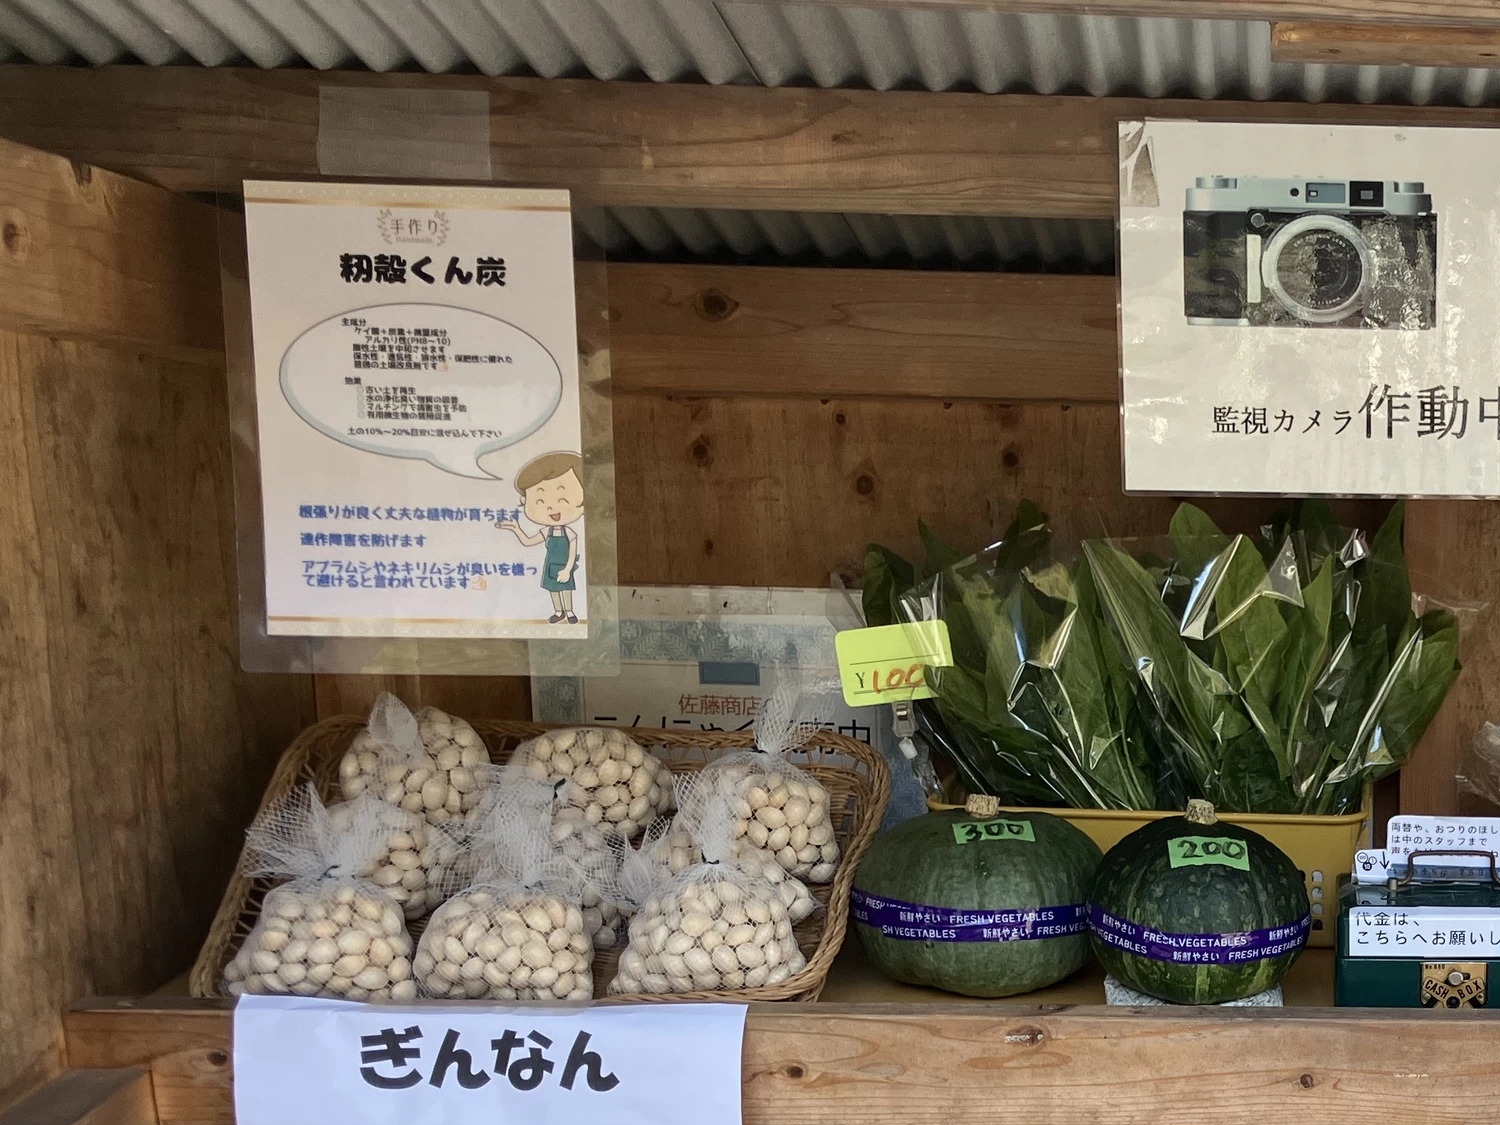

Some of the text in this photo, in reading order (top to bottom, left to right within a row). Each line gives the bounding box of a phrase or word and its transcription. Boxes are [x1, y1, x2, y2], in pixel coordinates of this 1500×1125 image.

[390, 218, 438, 236] 手作り
[339, 254, 507, 287] 籾殻くん炭
[299, 505, 523, 521] 根張りが良く丈夫な植物が育ちます
[300, 532, 427, 547] 連作障害を防げます
[960, 820, 1025, 843] 300
[1391, 836, 1488, 846] は中のスタッフまで
[1176, 838, 1247, 862] 200
[899, 911, 942, 924] 新鮮やさい
[949, 911, 1054, 924] FRESH VEGETABLES
[1102, 913, 1136, 936] 新鮮やさい
[1355, 911, 1421, 928] 代金は、
[894, 926, 956, 939] VEGETABLES
[983, 927, 1031, 940] 新鮮やさい
[1037, 924, 1067, 936] FRESH
[1268, 924, 1299, 942] 新鮮やさい
[1143, 931, 1247, 949] FRESH VEGETABLES
[1228, 936, 1304, 961] FRESH VEGETABLES
[1172, 951, 1220, 963] 新鮮やさい
[1425, 979, 1481, 999] CASH BOX
[359, 1024, 620, 1093] ぎんなん
